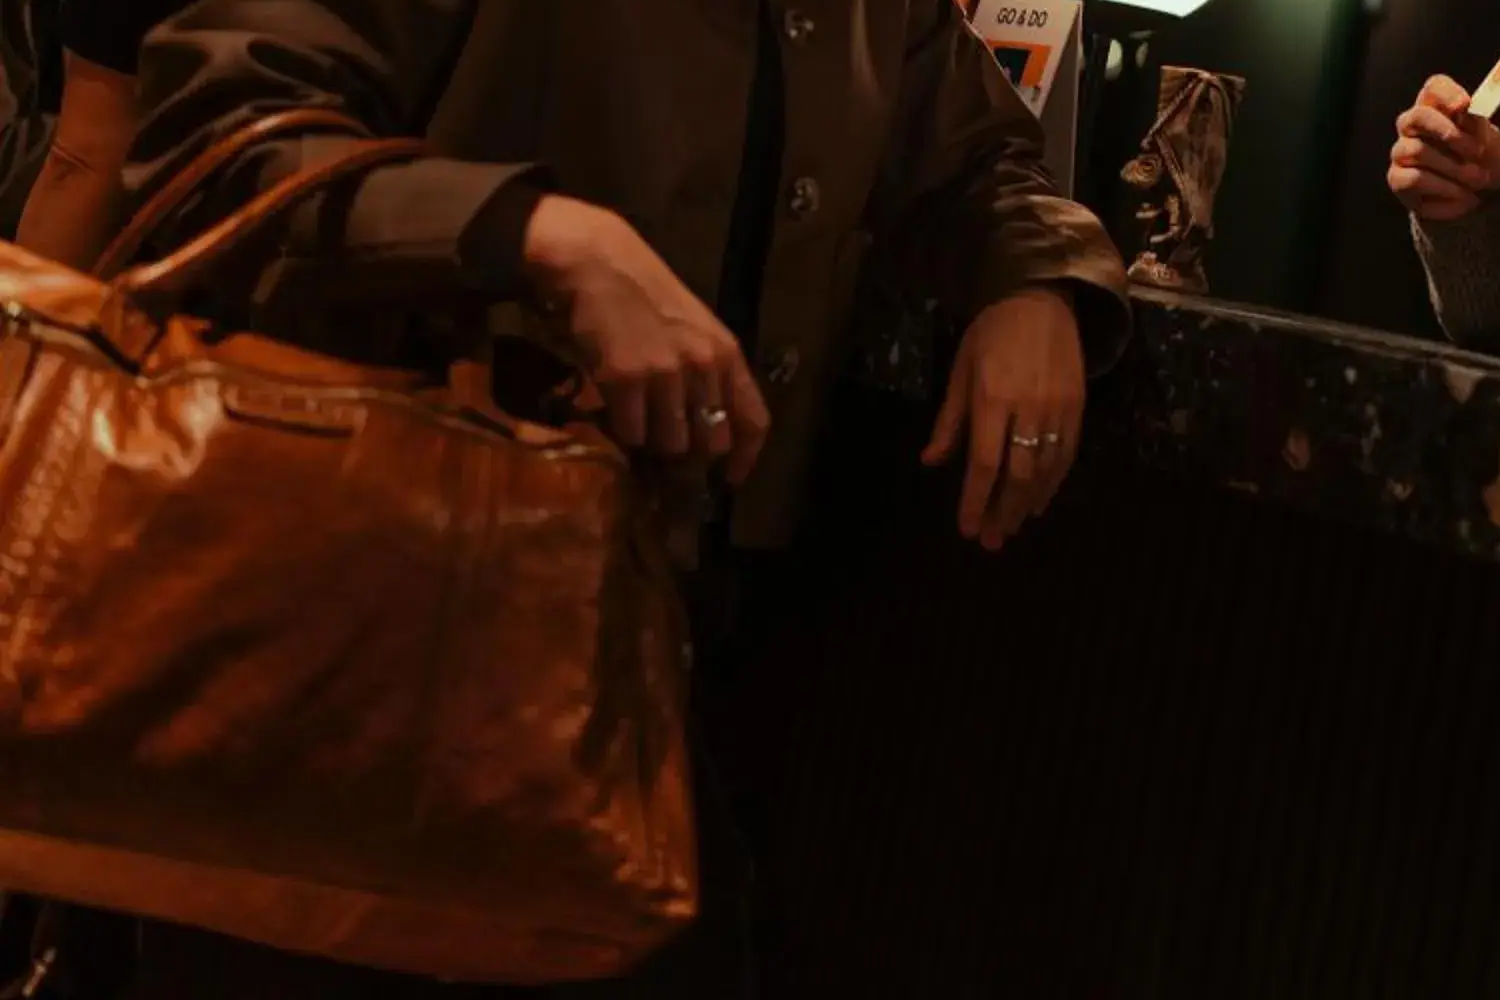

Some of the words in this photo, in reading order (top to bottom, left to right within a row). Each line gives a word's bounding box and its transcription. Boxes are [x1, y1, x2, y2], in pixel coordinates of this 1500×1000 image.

[997, 7, 1016, 24] GO
[1017, 9, 1026, 25] &
[1027, 9, 1048, 27] DO
